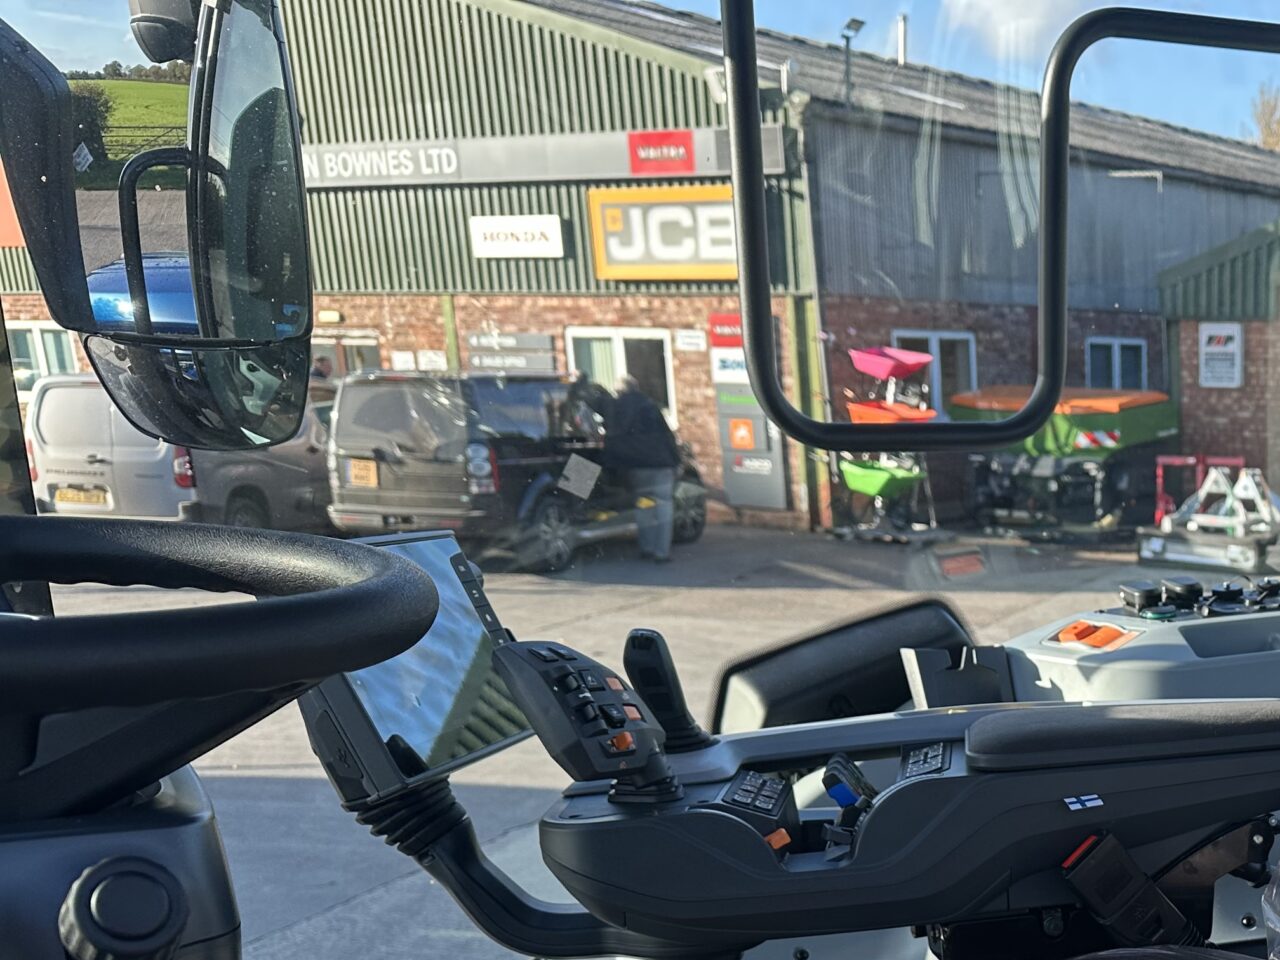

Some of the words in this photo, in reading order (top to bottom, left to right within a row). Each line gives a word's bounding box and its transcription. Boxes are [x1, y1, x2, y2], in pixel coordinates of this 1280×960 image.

[324, 148, 414, 178] BOWNES
[418, 147, 458, 175] LTD
[482, 231, 550, 242] HONDA
